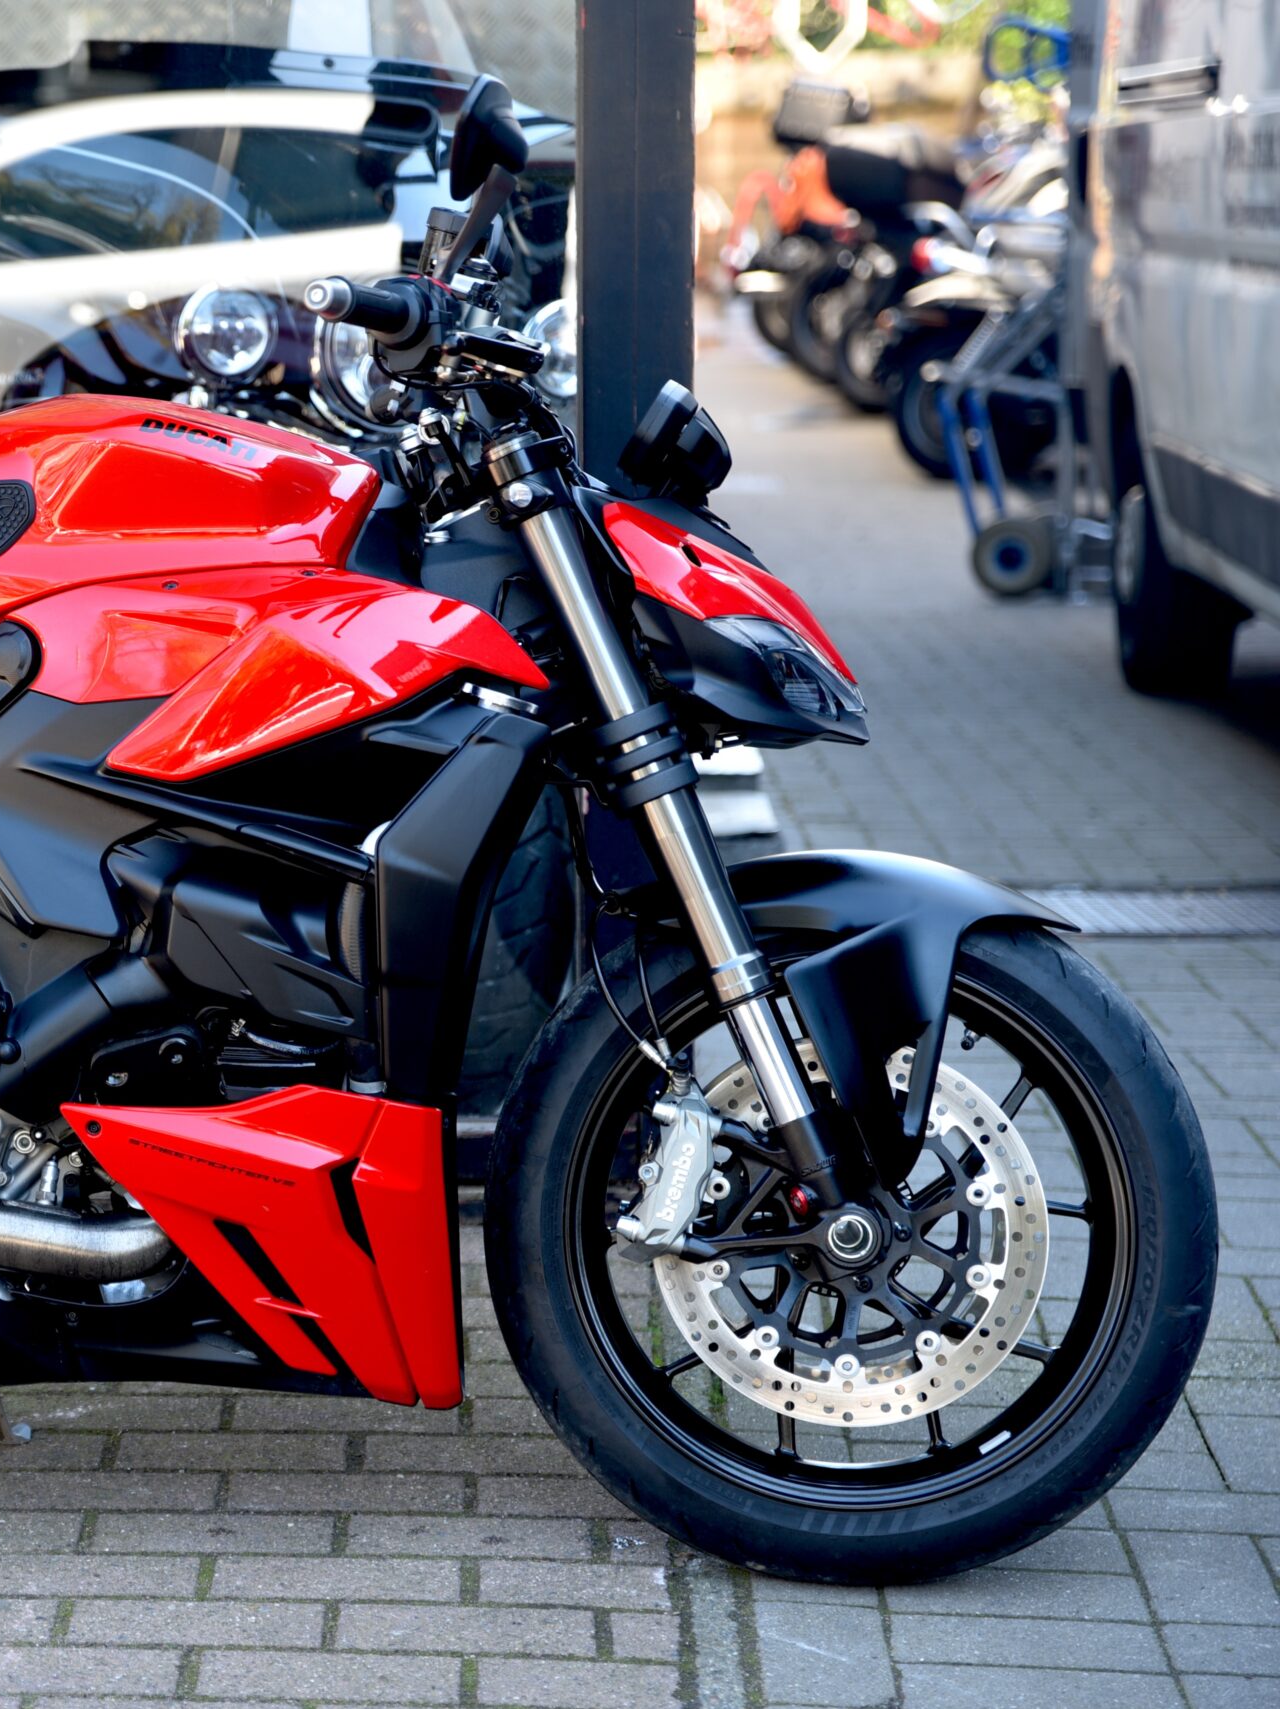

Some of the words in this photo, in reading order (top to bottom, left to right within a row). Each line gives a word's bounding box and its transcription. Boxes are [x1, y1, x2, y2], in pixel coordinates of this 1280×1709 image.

[139, 418, 258, 461] DUCATI
[129, 1138, 269, 1181] STREETFIGHTER
[272, 1177, 296, 1188] V2
[656, 1143, 695, 1222] brembo
